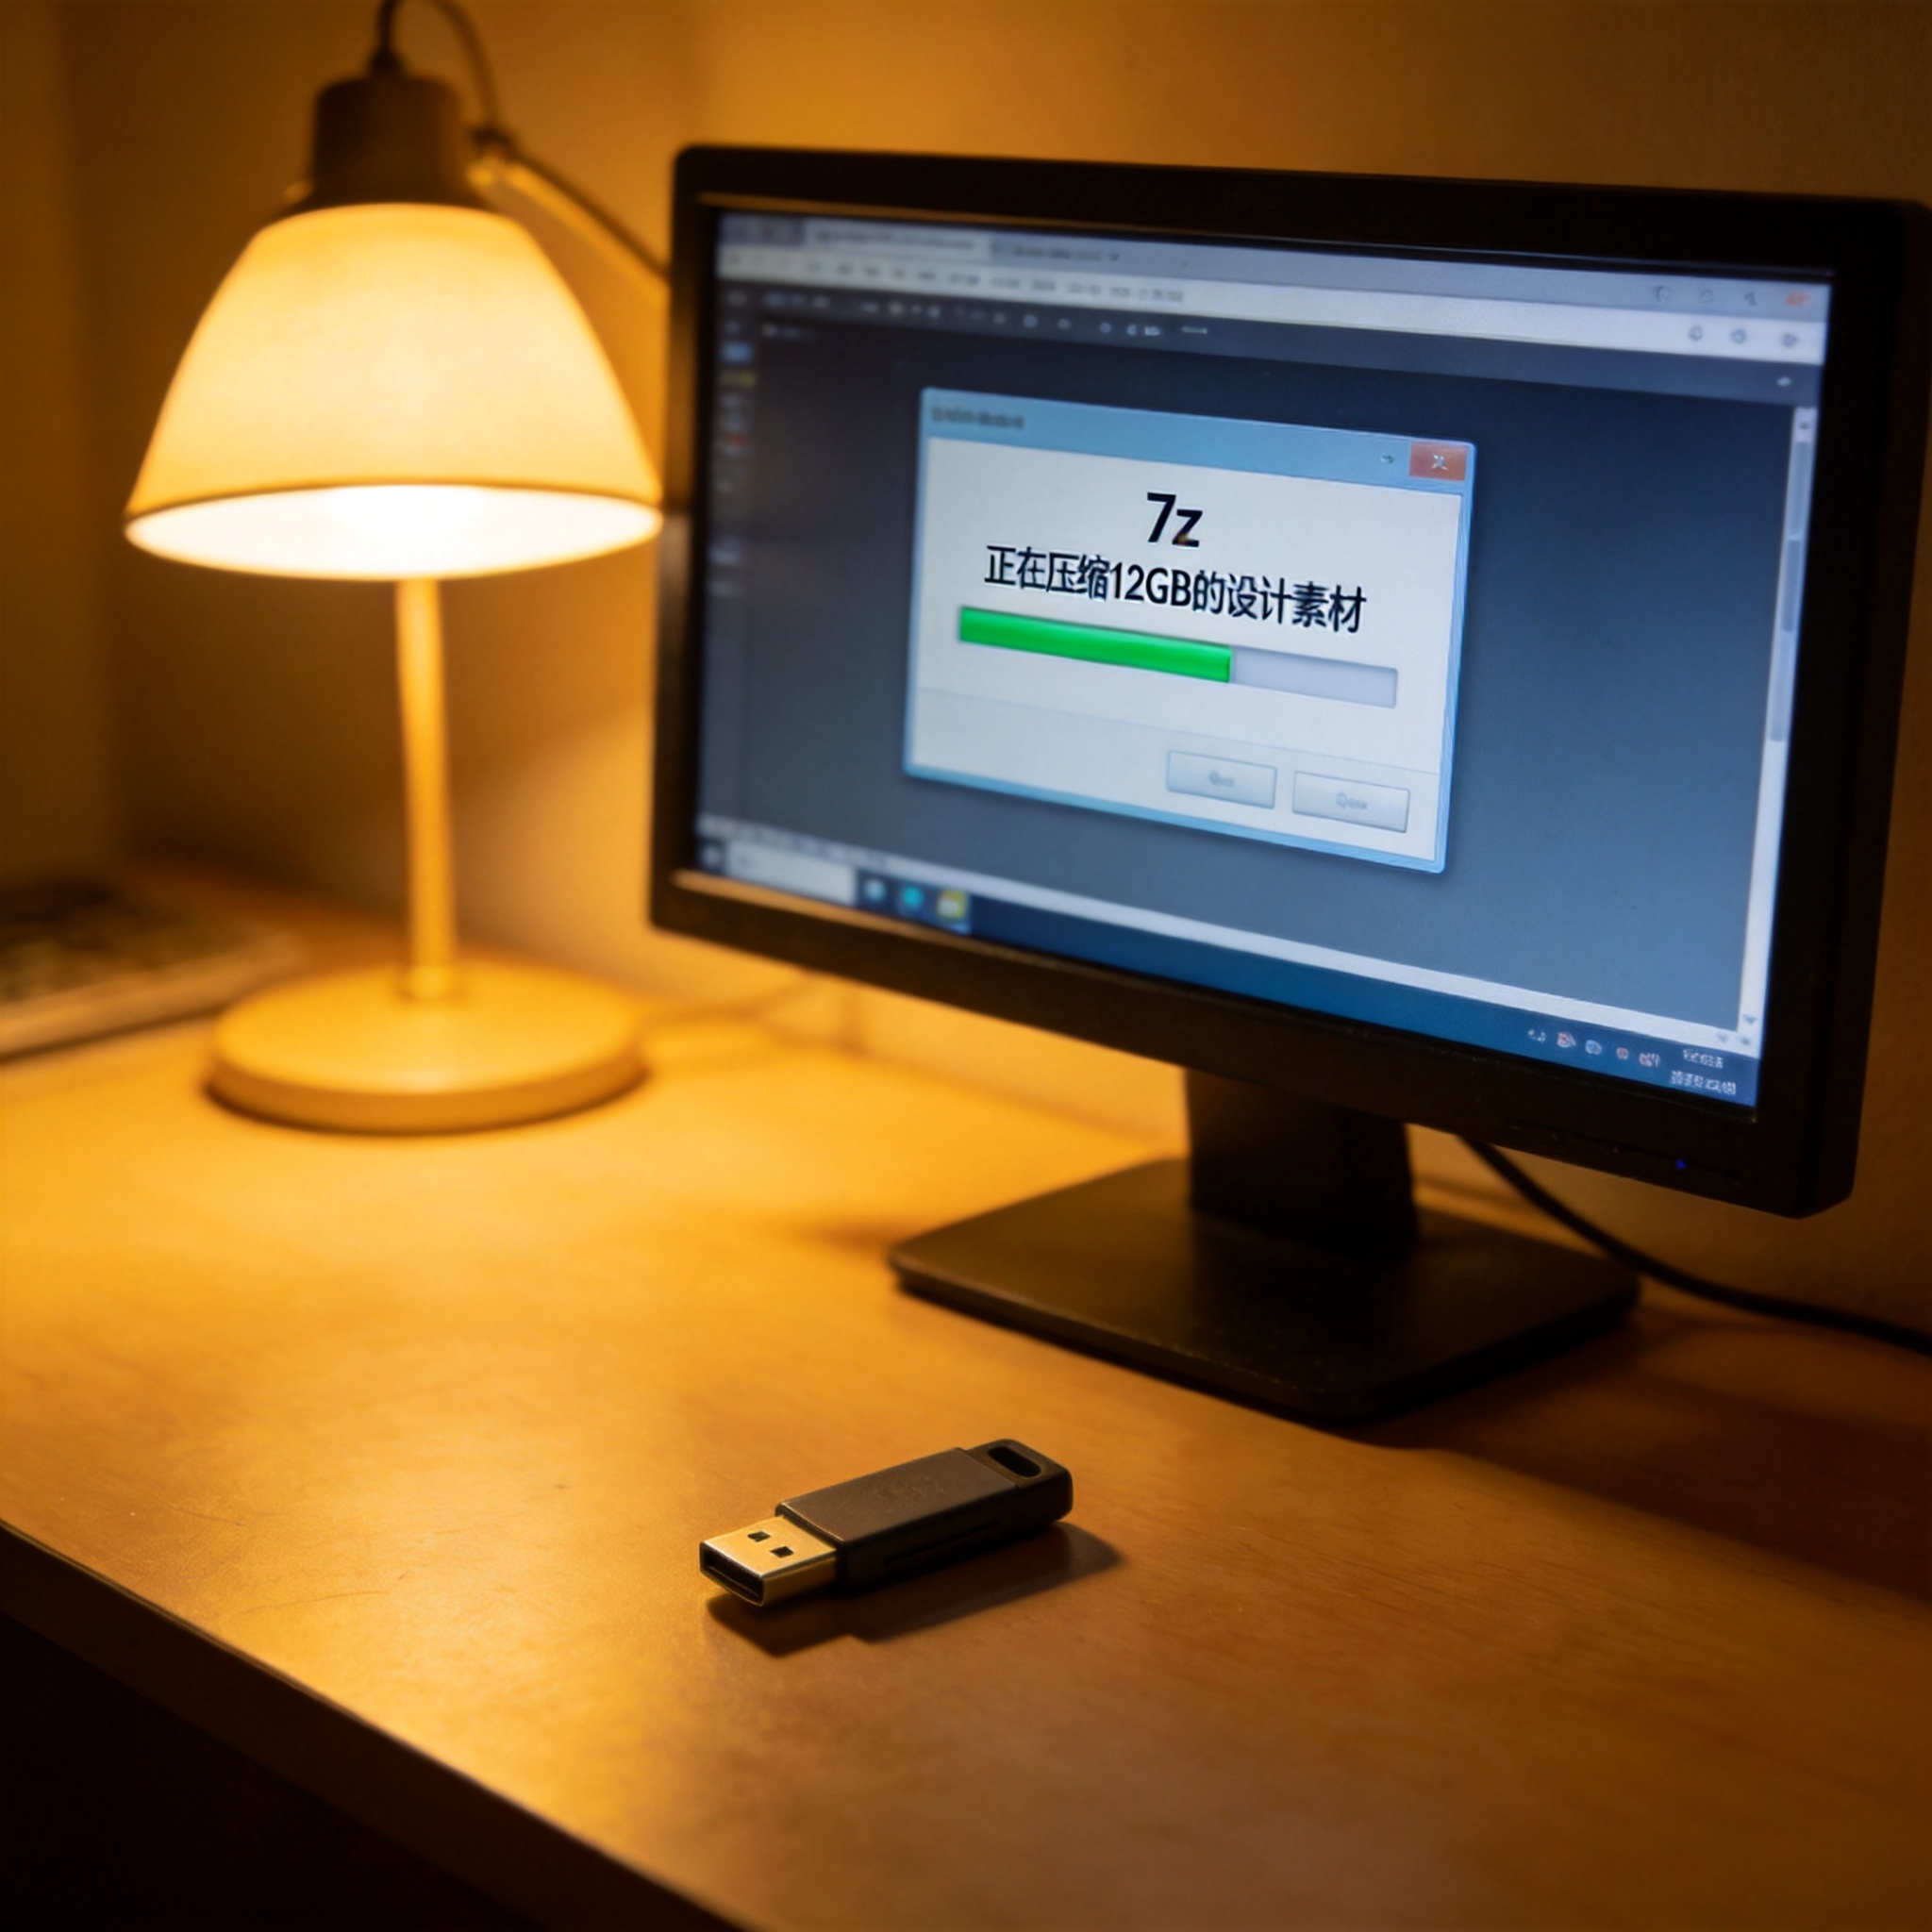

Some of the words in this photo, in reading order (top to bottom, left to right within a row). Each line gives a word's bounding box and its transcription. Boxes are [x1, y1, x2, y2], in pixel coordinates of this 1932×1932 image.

[1146, 492, 1204, 548] 7z
[984, 545, 1367, 633] 正在压缩12GB的设计素材
